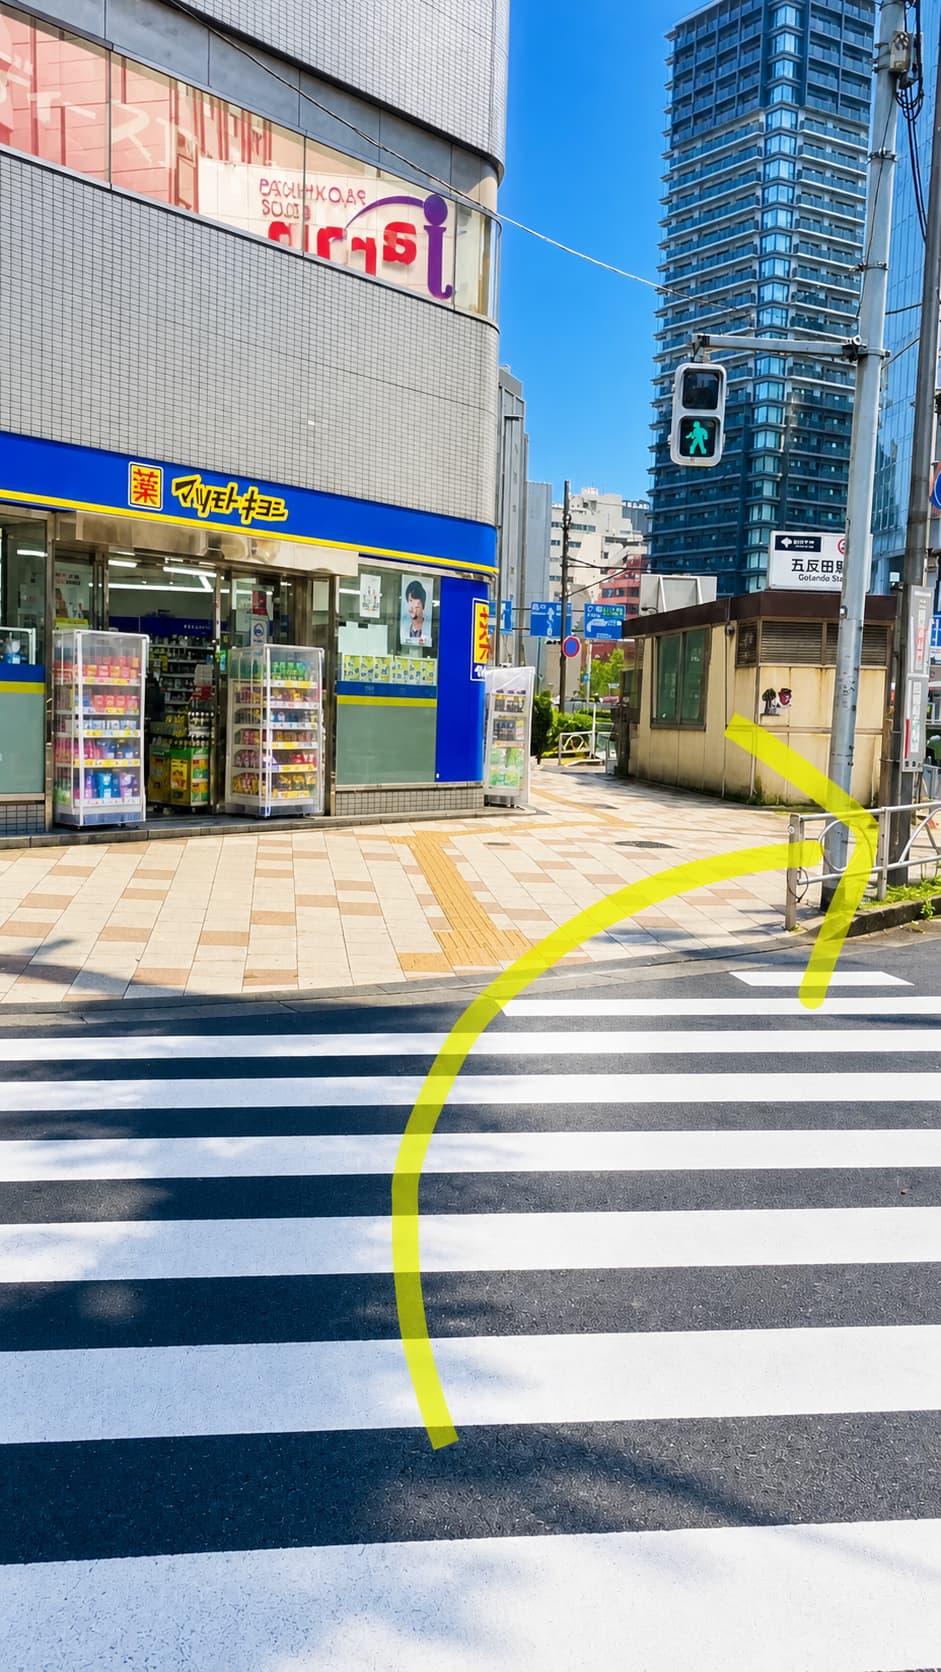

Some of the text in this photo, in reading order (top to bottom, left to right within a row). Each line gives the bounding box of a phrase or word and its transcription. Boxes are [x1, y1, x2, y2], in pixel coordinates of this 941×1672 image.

[133, 468, 159, 505] 薬
[173, 476, 287, 522] マツモトキヨシ
